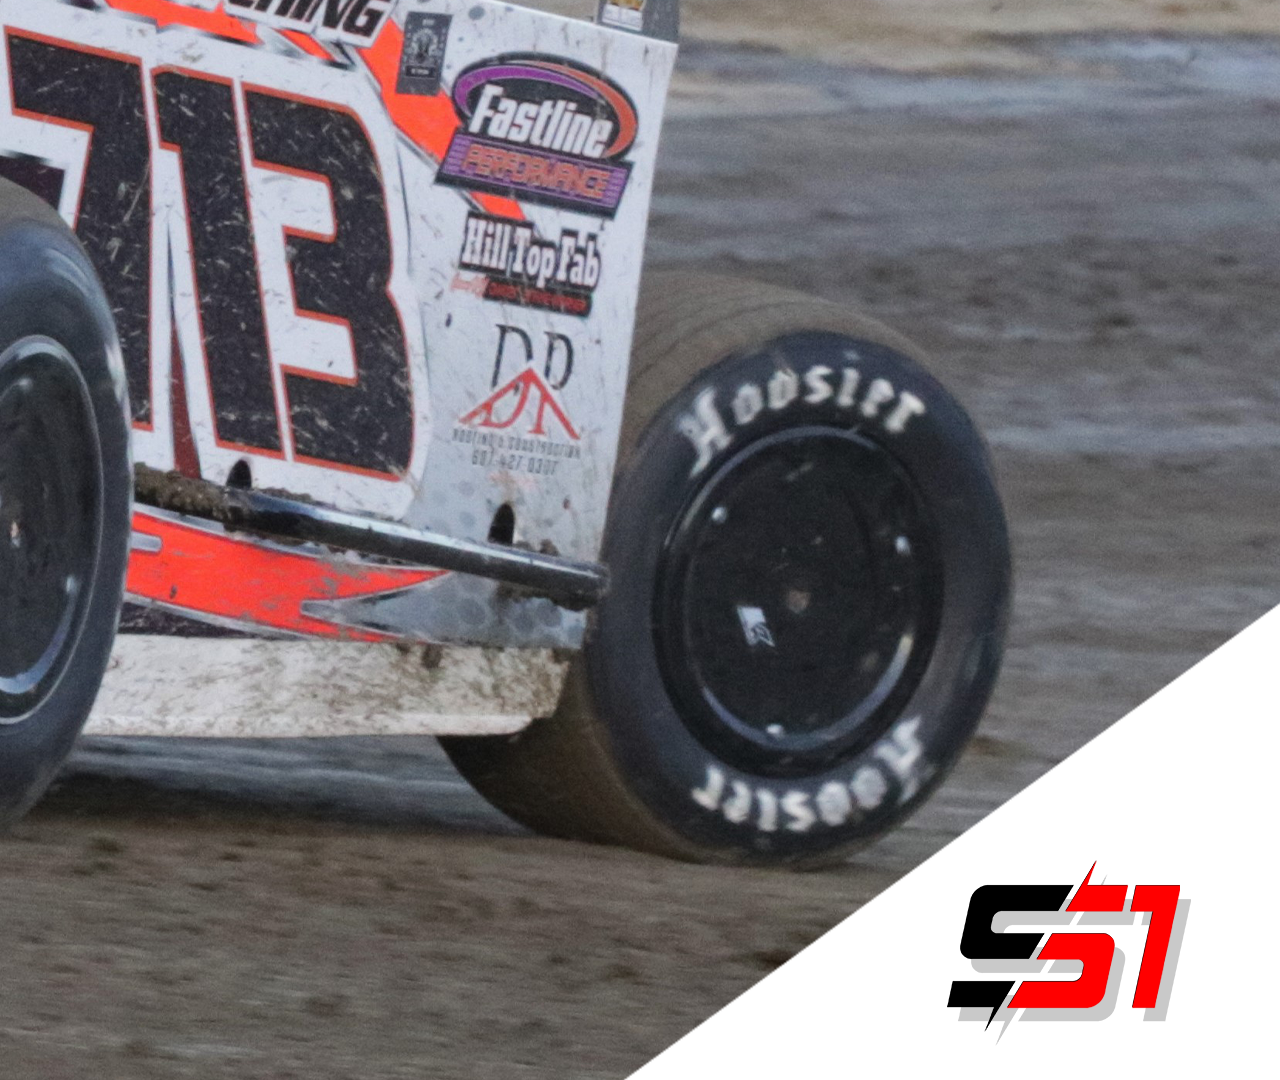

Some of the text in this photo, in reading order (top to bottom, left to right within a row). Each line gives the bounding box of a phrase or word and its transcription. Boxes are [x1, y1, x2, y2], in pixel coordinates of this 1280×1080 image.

[467, 84, 613, 158] Fastline
[461, 143, 612, 199] PERFORMANCE
[4, 25, 414, 482] 713
[461, 217, 601, 289] Hill Top Fab
[678, 364, 926, 479] Hoosier
